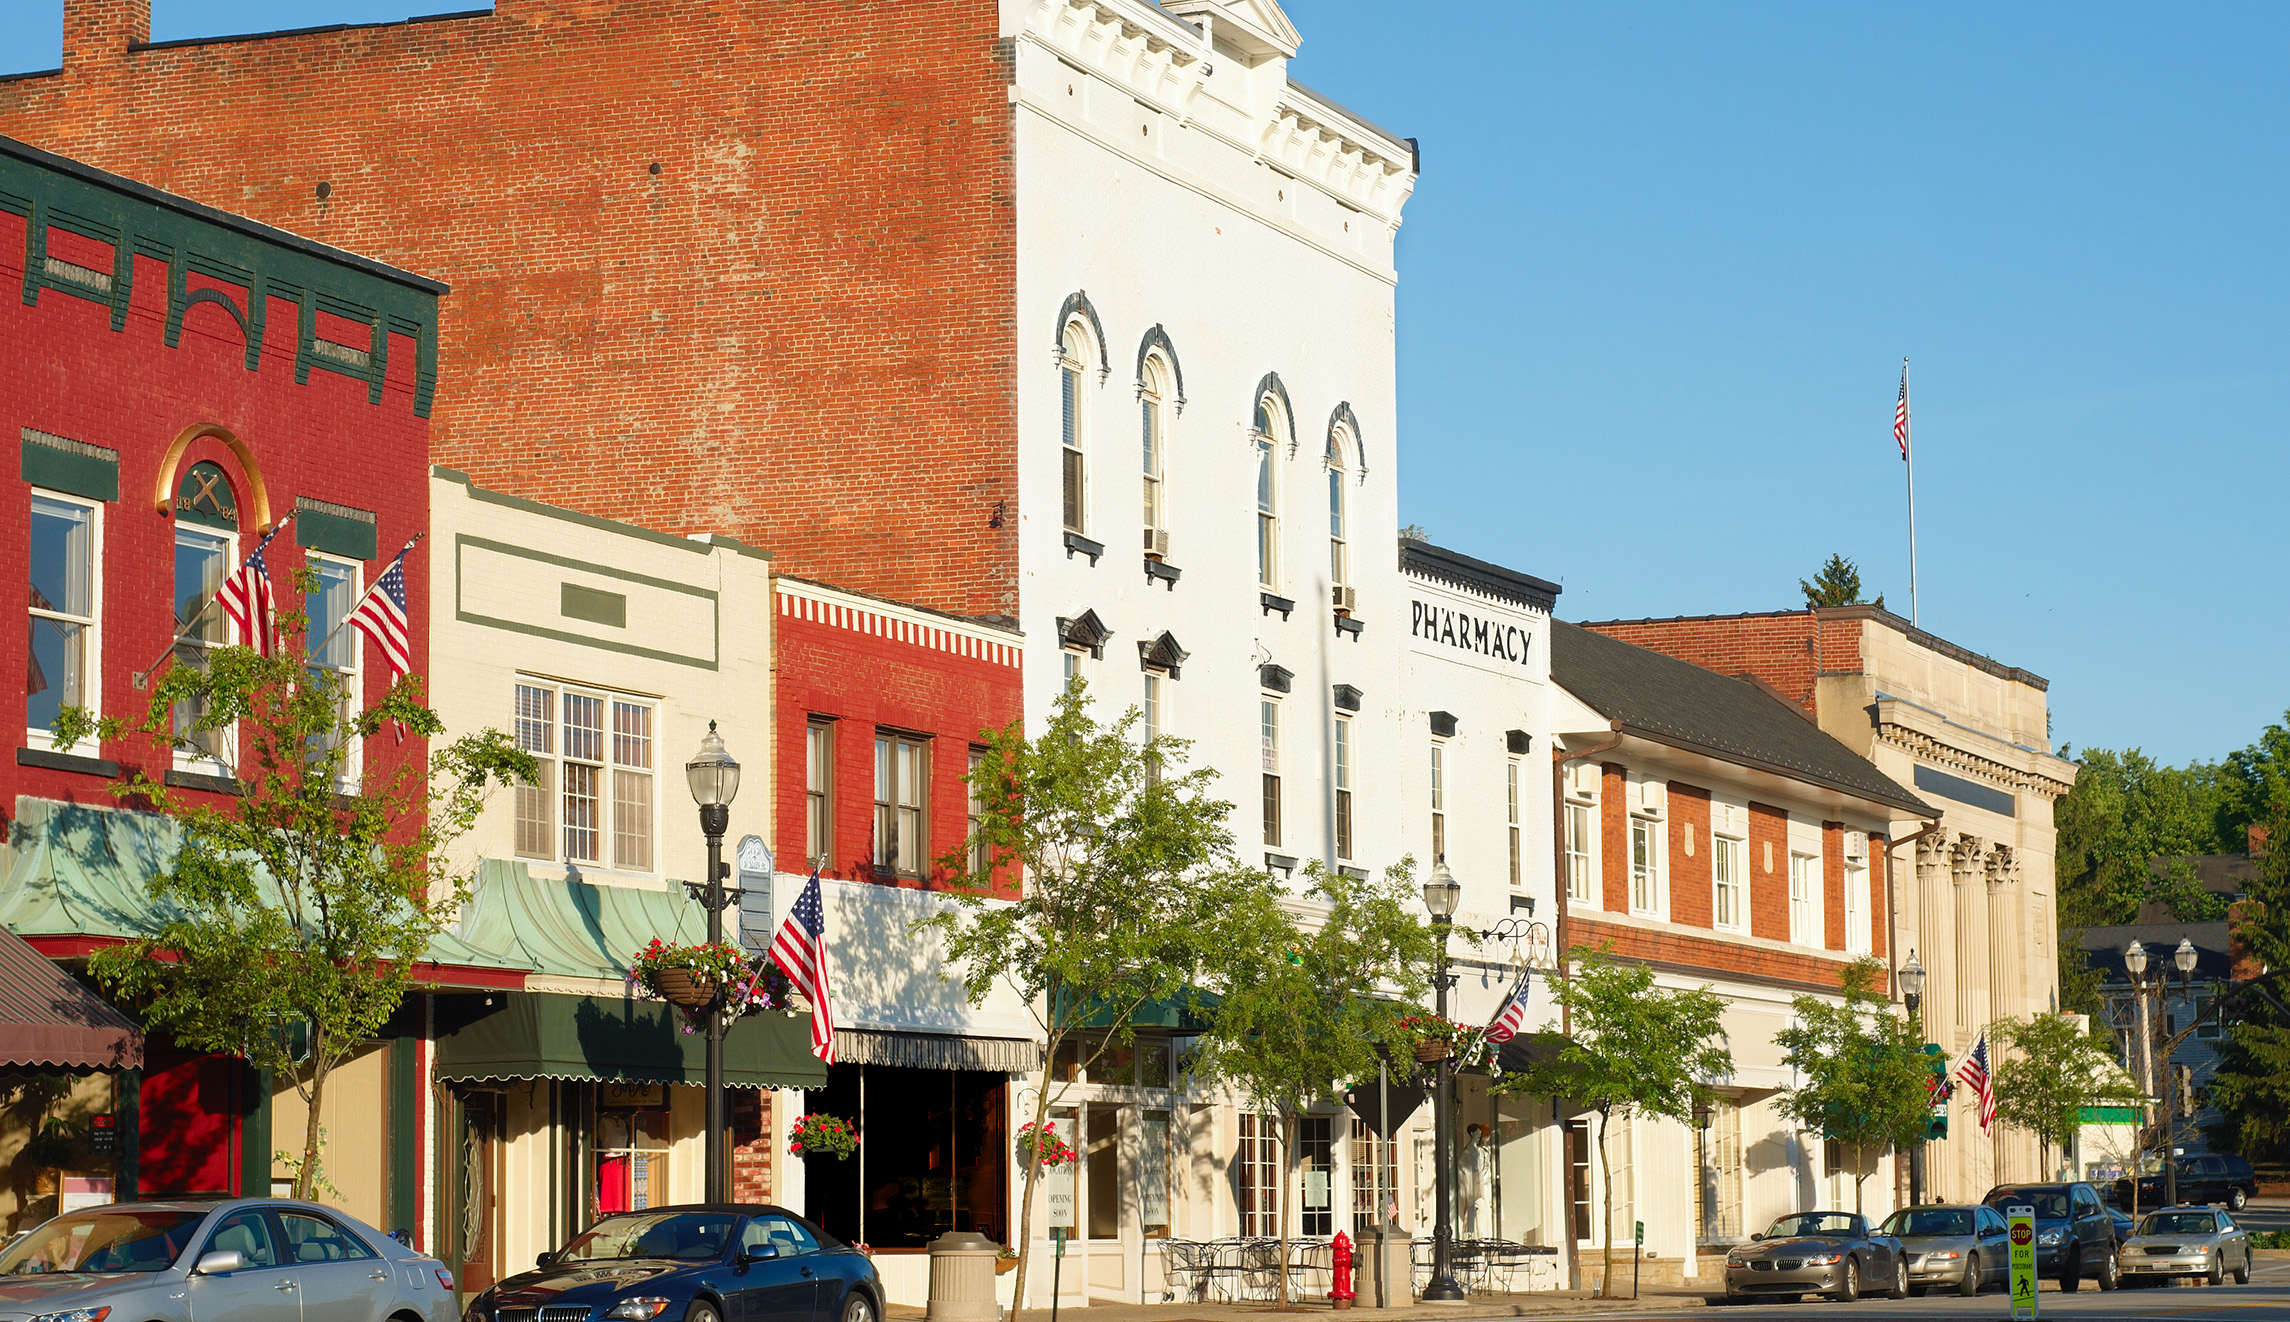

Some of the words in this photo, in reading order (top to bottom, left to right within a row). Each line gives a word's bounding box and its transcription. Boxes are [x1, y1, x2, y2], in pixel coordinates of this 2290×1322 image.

[1411, 600, 1532, 666] PHARMACY
[1048, 1194, 1072, 1204] OPENING
[1052, 1208, 1068, 1218] SOON
[2011, 1230, 2032, 1239] STOP
[2014, 1250, 2030, 1258] FOR
